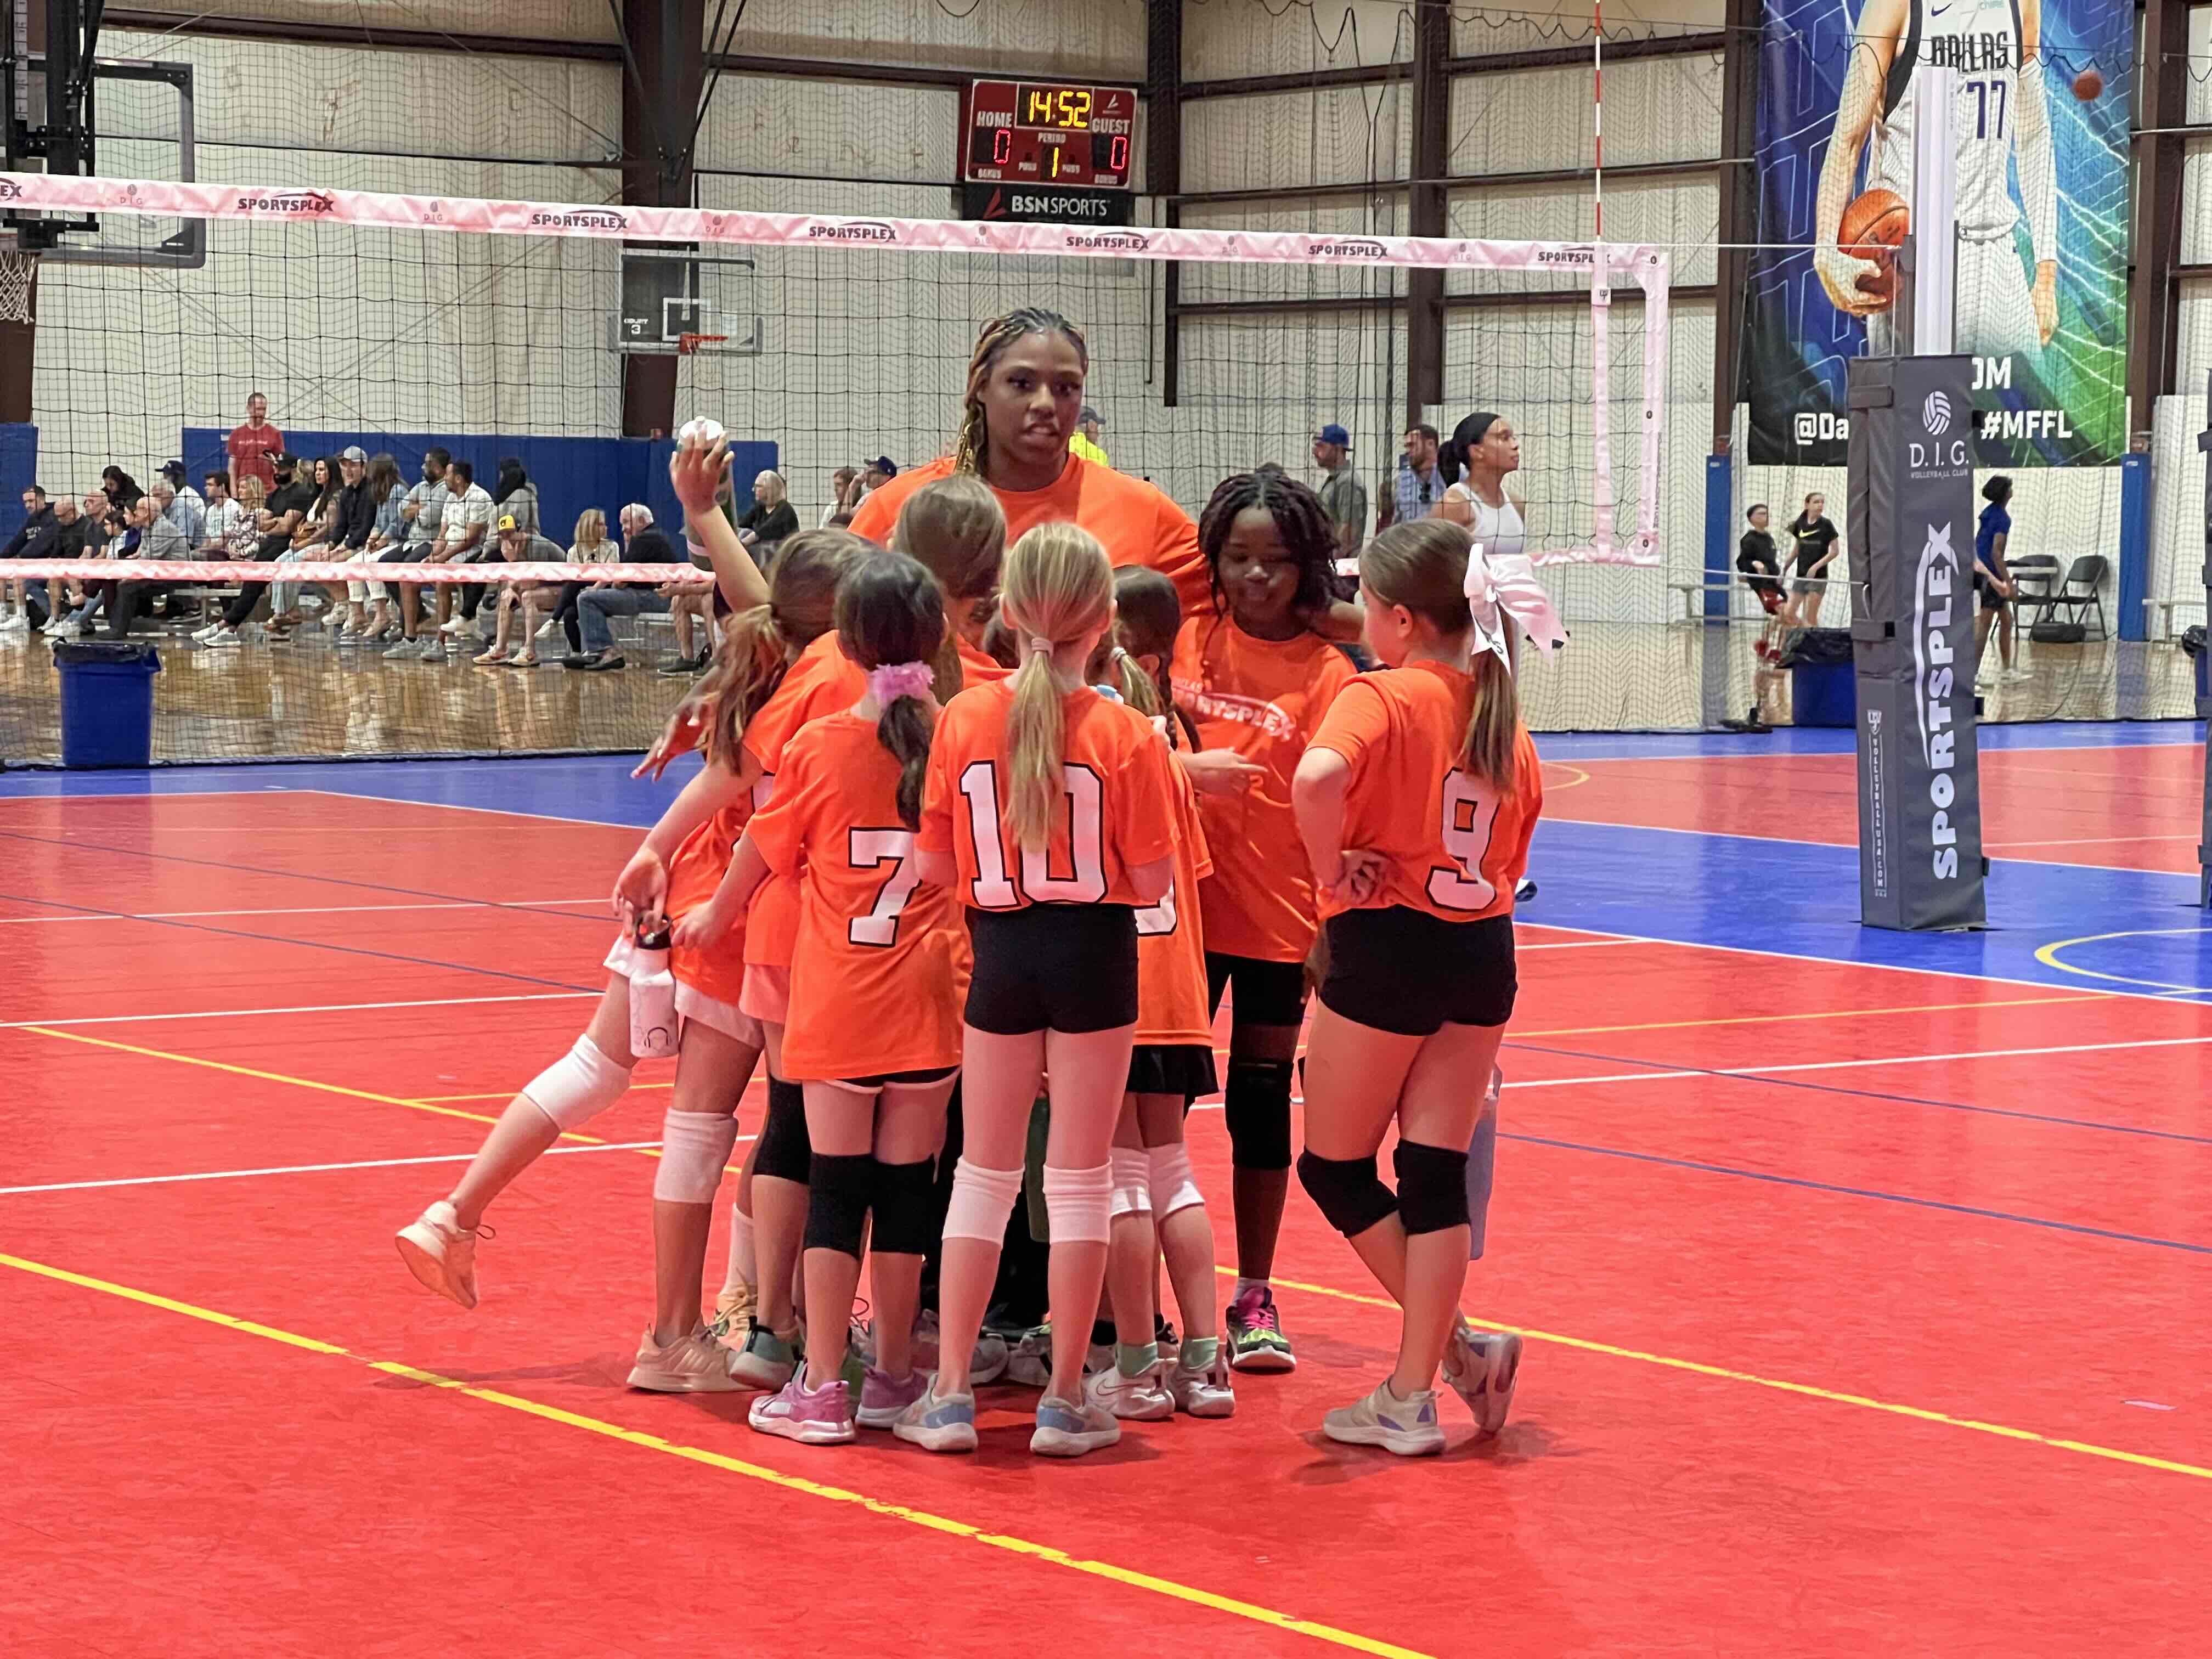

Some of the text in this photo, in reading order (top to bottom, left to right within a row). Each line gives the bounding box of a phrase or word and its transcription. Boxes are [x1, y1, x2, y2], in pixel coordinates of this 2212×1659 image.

[1967, 81, 2006, 140] 77
[977, 111, 1013, 128] HOME
[1092, 118, 1130, 134] GUEST
[994, 129, 1011, 163] 0
[1110, 137, 1127, 170] 0
[1052, 147, 1059, 178] 1
[238, 198, 334, 213] SPORTSPLEX
[532, 213, 628, 230] SPORTSPLEX
[809, 225, 896, 241] SPORTSPLEX
[1066, 236, 1149, 251] SPORTSPLEX
[1308, 245, 1388, 258] SPORTSPLEX
[1538, 251, 1611, 264] SPORTSPL
[631, 325, 641, 335] 3
[1980, 410, 2072, 439] #MFFL
[1910, 470, 1950, 479] VOLLEYBALL
[1927, 521, 1958, 879] SPORTSPLEX
[958, 759, 1108, 909] 10
[1425, 766, 1500, 913] 9
[848, 826, 922, 947] 7
